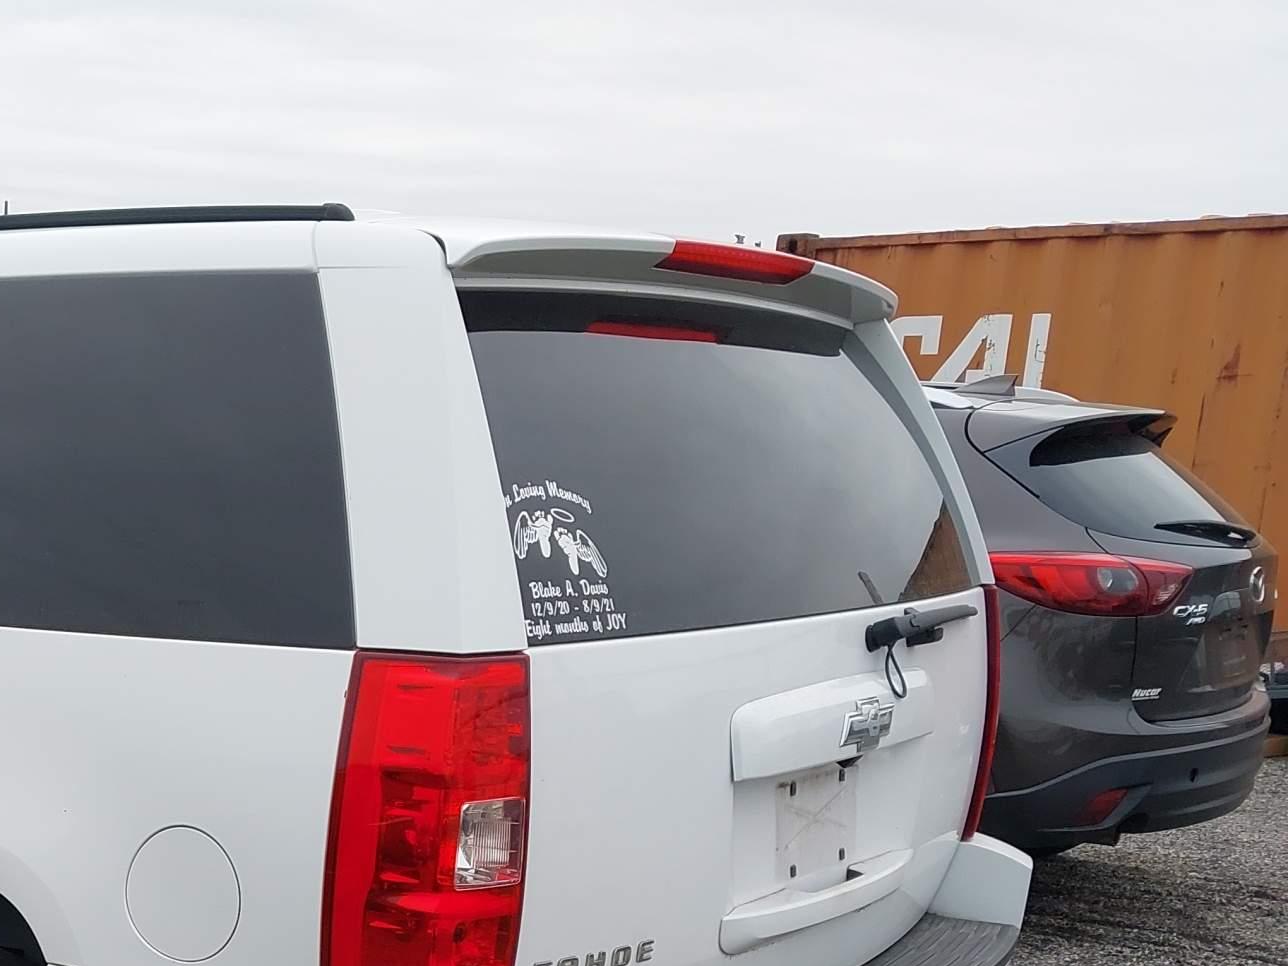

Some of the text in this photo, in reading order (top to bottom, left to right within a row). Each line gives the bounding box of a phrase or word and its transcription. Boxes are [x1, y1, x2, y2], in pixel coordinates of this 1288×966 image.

[512, 482, 546, 503] Loving
[545, 479, 592, 515] Memory
[528, 579, 609, 599] Blake A. Davis
[531, 600, 570, 617] 12/9/20
[582, 597, 615, 614] 8/9/21
[1172, 603, 1209, 617] CX-5
[525, 612, 627, 640] Eight months of JOY
